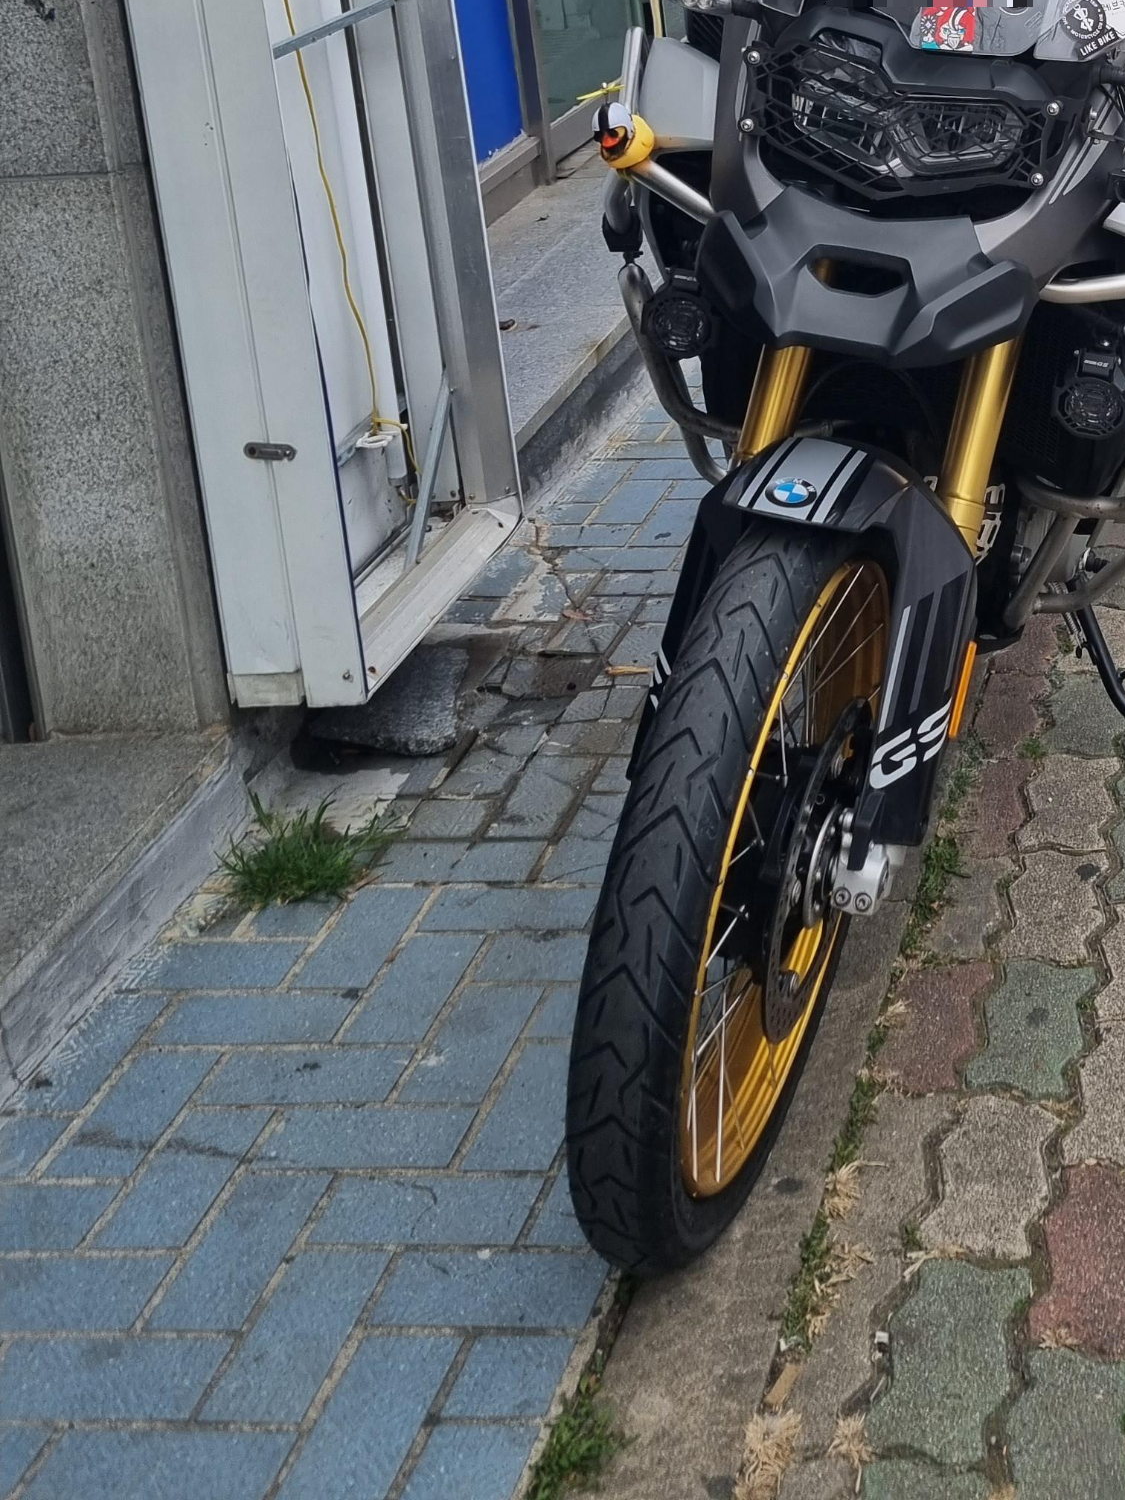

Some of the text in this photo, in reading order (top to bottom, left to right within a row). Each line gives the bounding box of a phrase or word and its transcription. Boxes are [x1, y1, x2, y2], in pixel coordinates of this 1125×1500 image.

[1080, 31, 1115, 56] LIKE BIKE
[869, 697, 953, 790] GS
